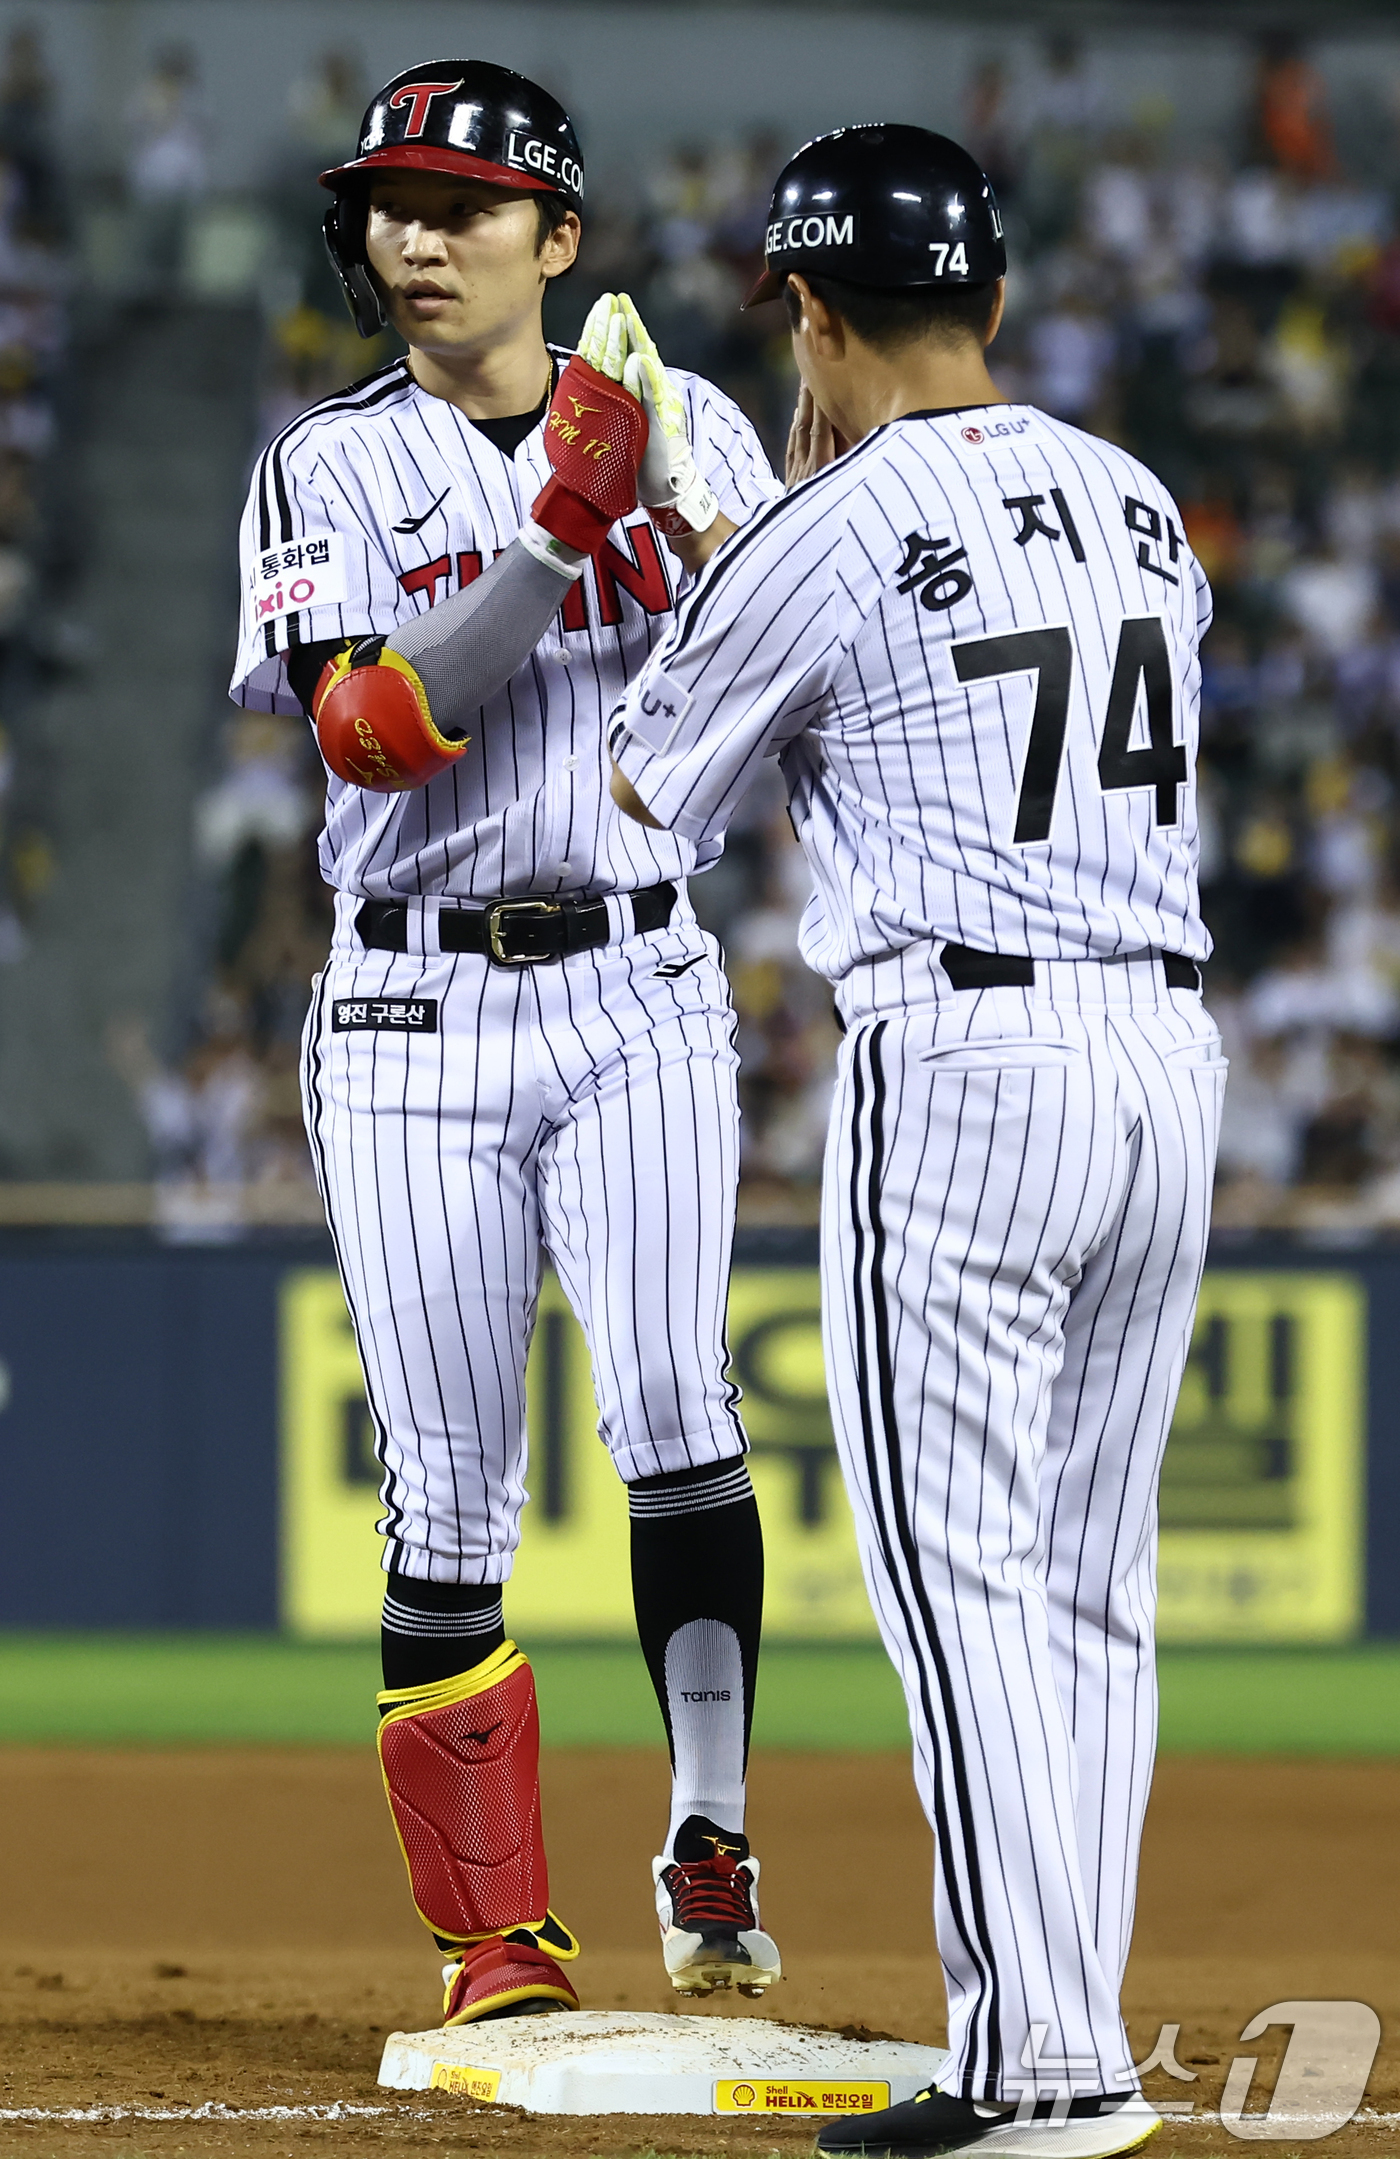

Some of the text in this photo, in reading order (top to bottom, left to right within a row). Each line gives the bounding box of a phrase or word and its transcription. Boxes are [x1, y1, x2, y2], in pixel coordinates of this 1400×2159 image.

[390, 78, 465, 138] T
[508, 132, 584, 200] LGE.CO
[764, 214, 854, 256] GE.COM
[929, 242, 969, 276] 74
[260, 539, 330, 581] 통화앱
[949, 615, 1188, 846] 74
[337, 1003, 426, 1025] 영진 구론산
[765, 2085, 788, 2095] Shell
[765, 2092, 873, 2110] HELIX 엔진오일
